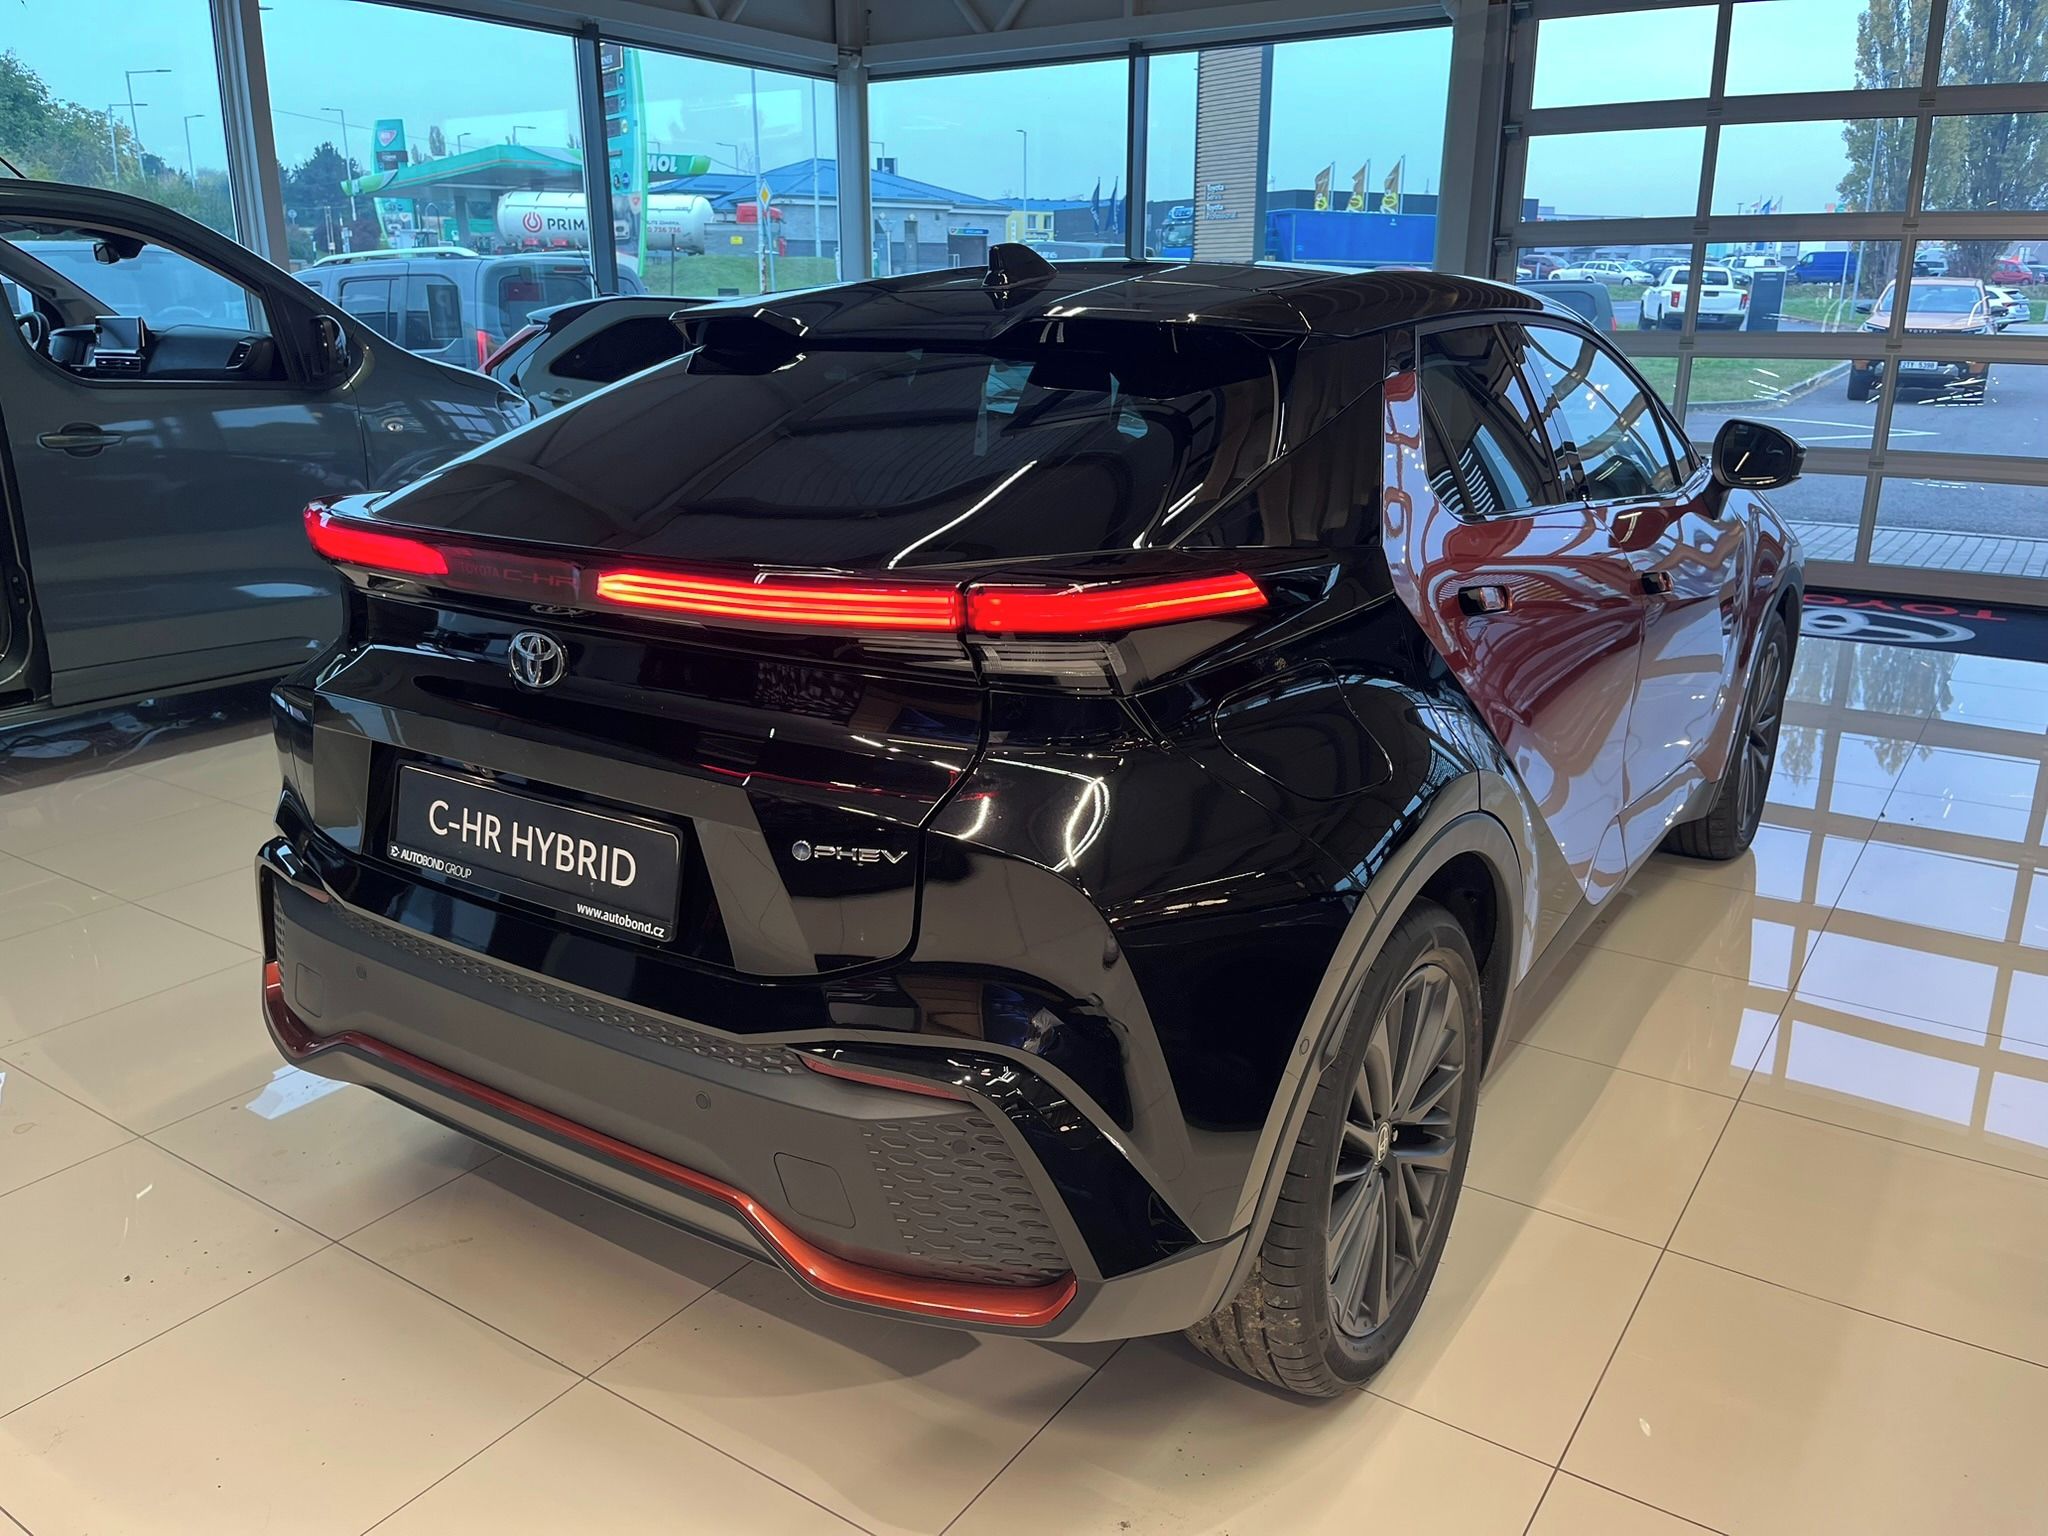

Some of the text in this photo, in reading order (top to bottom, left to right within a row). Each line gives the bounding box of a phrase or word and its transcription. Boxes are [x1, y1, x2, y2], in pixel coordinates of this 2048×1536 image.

[547, 218, 588, 231] PRIM
[1803, 594, 2007, 621] TOYO
[428, 800, 637, 887] C-HR HYBRID
[814, 845, 908, 864] PHEV
[400, 849, 472, 879] AUTOBOND GROUP
[576, 903, 665, 938] www.autobond.cz
